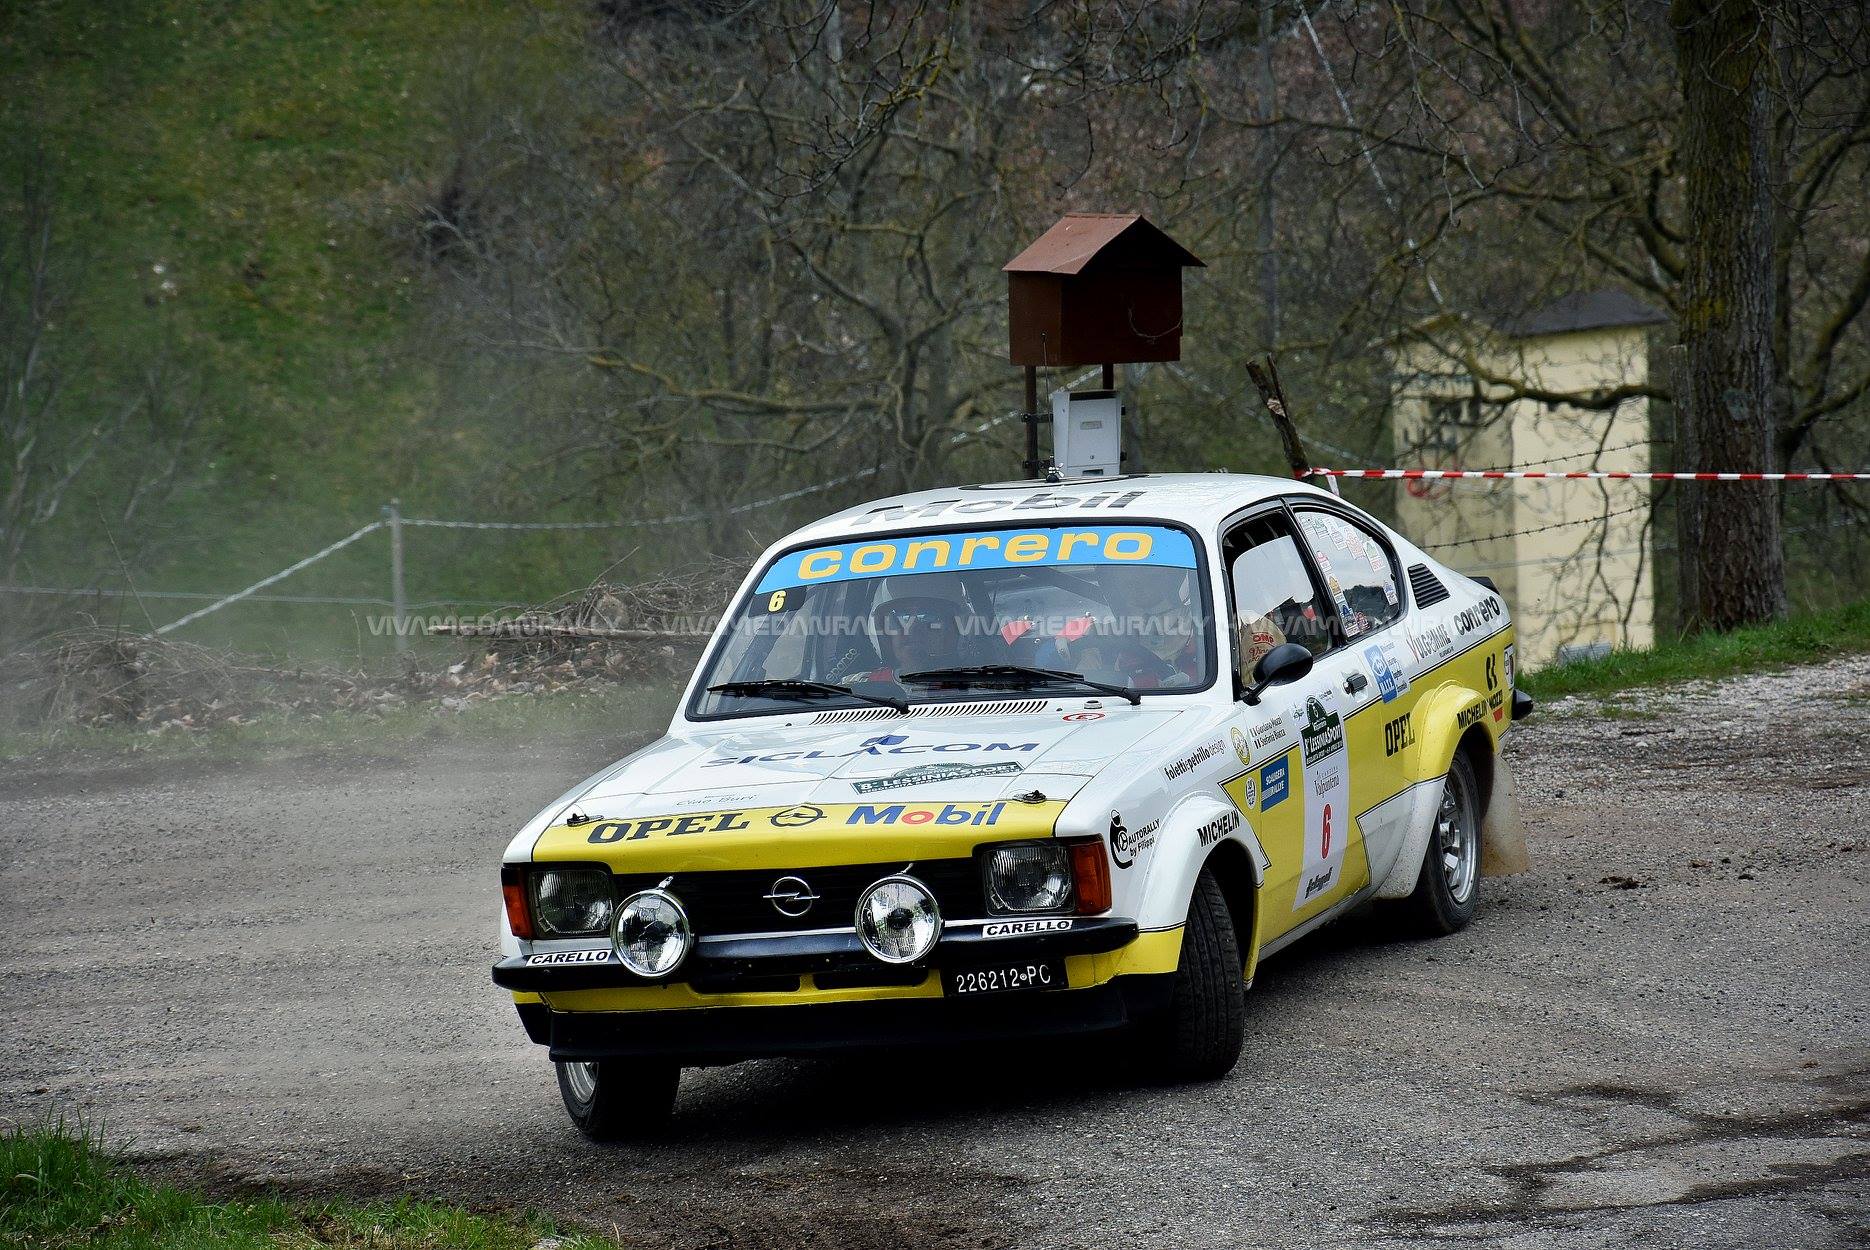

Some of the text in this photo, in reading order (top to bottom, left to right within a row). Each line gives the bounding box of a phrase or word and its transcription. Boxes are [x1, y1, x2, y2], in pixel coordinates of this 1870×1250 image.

[850, 491, 1146, 527] Mobil
[797, 530, 1153, 581] conrero
[768, 590, 787, 612] 6
[1453, 595, 1501, 636] conrero
[1456, 699, 1488, 730] MICHELIN
[1385, 711, 1415, 757] OPEL
[700, 743, 1041, 767] SIGLACOM
[587, 801, 1007, 844] OPEL Mobil
[1128, 818, 1161, 846] AUTORALLY
[1197, 808, 1241, 848] MICHELIN
[1321, 803, 1332, 860] 6
[985, 919, 1071, 936] CARELLO
[530, 950, 609, 965] CARELLO
